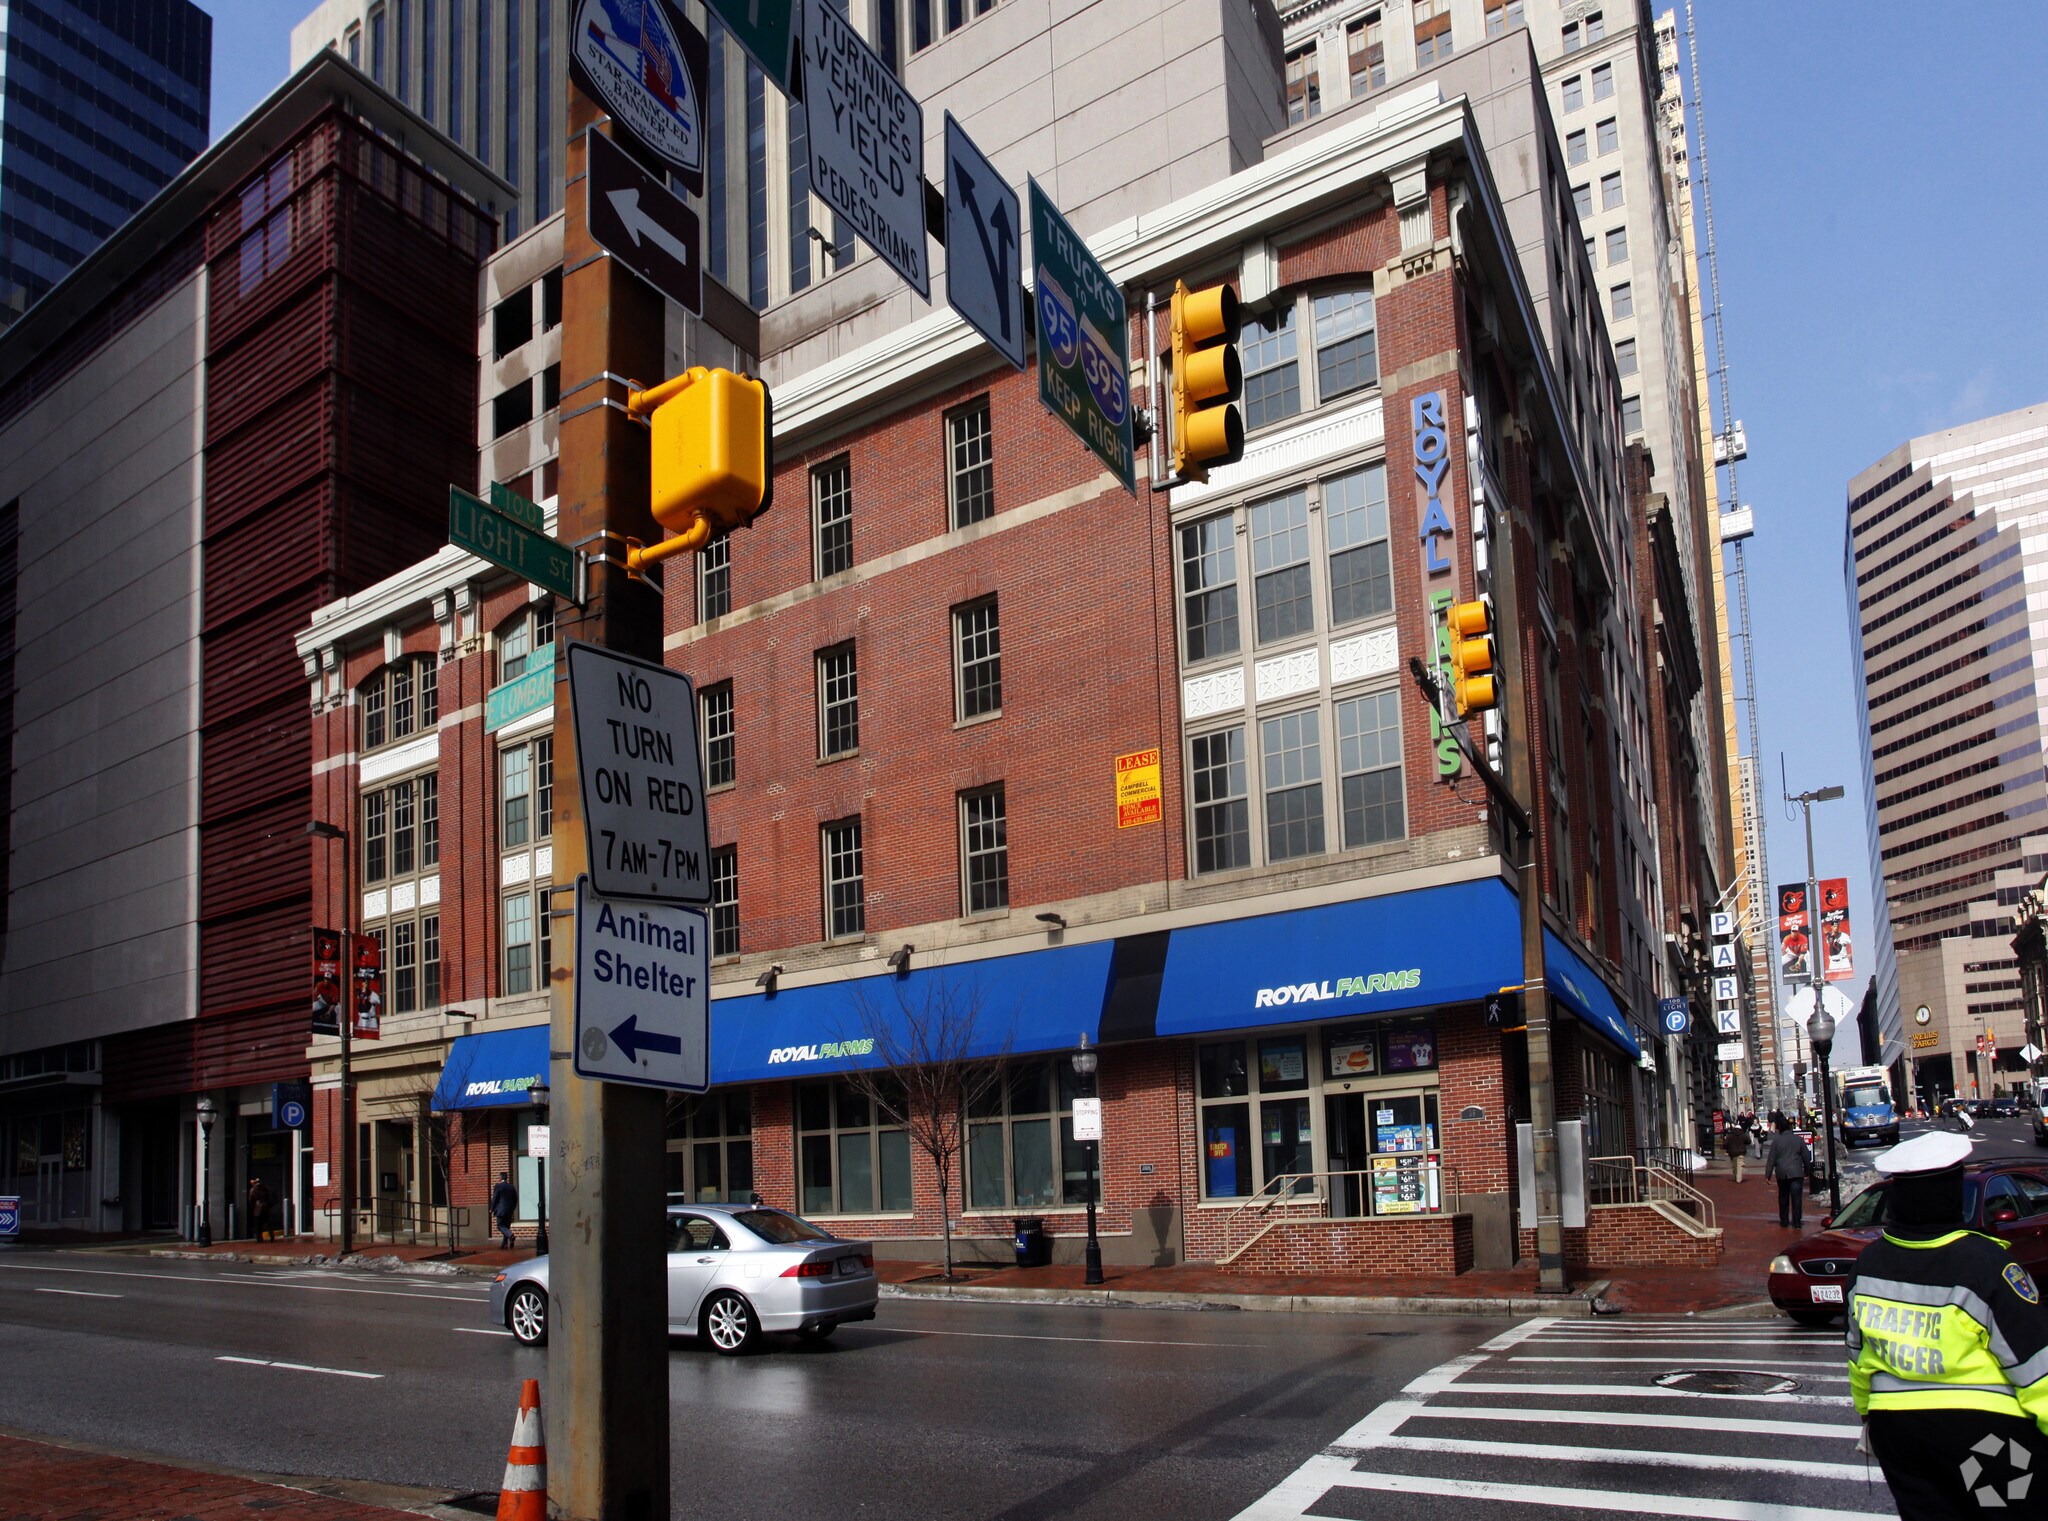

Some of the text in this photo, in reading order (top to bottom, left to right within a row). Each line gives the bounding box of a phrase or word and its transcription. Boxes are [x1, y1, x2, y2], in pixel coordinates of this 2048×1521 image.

[818, 3, 906, 124] TURNING
[588, 43, 689, 146] STAR-SPANGLED
[591, 67, 685, 158] NATIONAL HISTORIC TRAIL
[613, 81, 666, 139] BANNER
[815, 35, 912, 164] VEHICLES
[827, 87, 904, 197] YIELD
[859, 167, 879, 200] TO
[818, 155, 919, 280] PEDESTRIANS
[1043, 209, 1116, 321] TRUCKS
[1074, 280, 1087, 307] TO
[1043, 294, 1073, 355] 95
[1085, 346, 1123, 413] 395
[1046, 362, 1128, 472] KEEP RIGHT
[1412, 392, 1454, 575] ROYAL
[506, 490, 537, 523] 100
[454, 498, 570, 583] LIGHT ST.
[617, 671, 652, 713] NO
[606, 718, 674, 766] TURN
[1118, 752, 1157, 771] LEASE
[595, 767, 693, 816] ON RED
[1120, 781, 1149, 792] CAMPBELL
[1120, 786, 1157, 798] COMMERCIAL
[1122, 803, 1142, 811] SPACE
[1123, 804, 1157, 817] AVAILABLE
[596, 903, 695, 955] Animal
[593, 949, 697, 999] Shelter
[1255, 968, 1421, 1008] ROYAL FARMS
[1715, 914, 1736, 1030] PARK
[1671, 1015, 1682, 1028] P
[1912, 1031, 1939, 1041] WELLS
[1913, 1039, 1939, 1049] FARGO
[768, 1038, 874, 1064] ROYAL FARMS
[465, 1080, 501, 1096] ROYAL
[287, 1106, 300, 1122] P
[1855, 1301, 1941, 1340] TRAFFIC
[1866, 1335, 1945, 1375] FFICER
